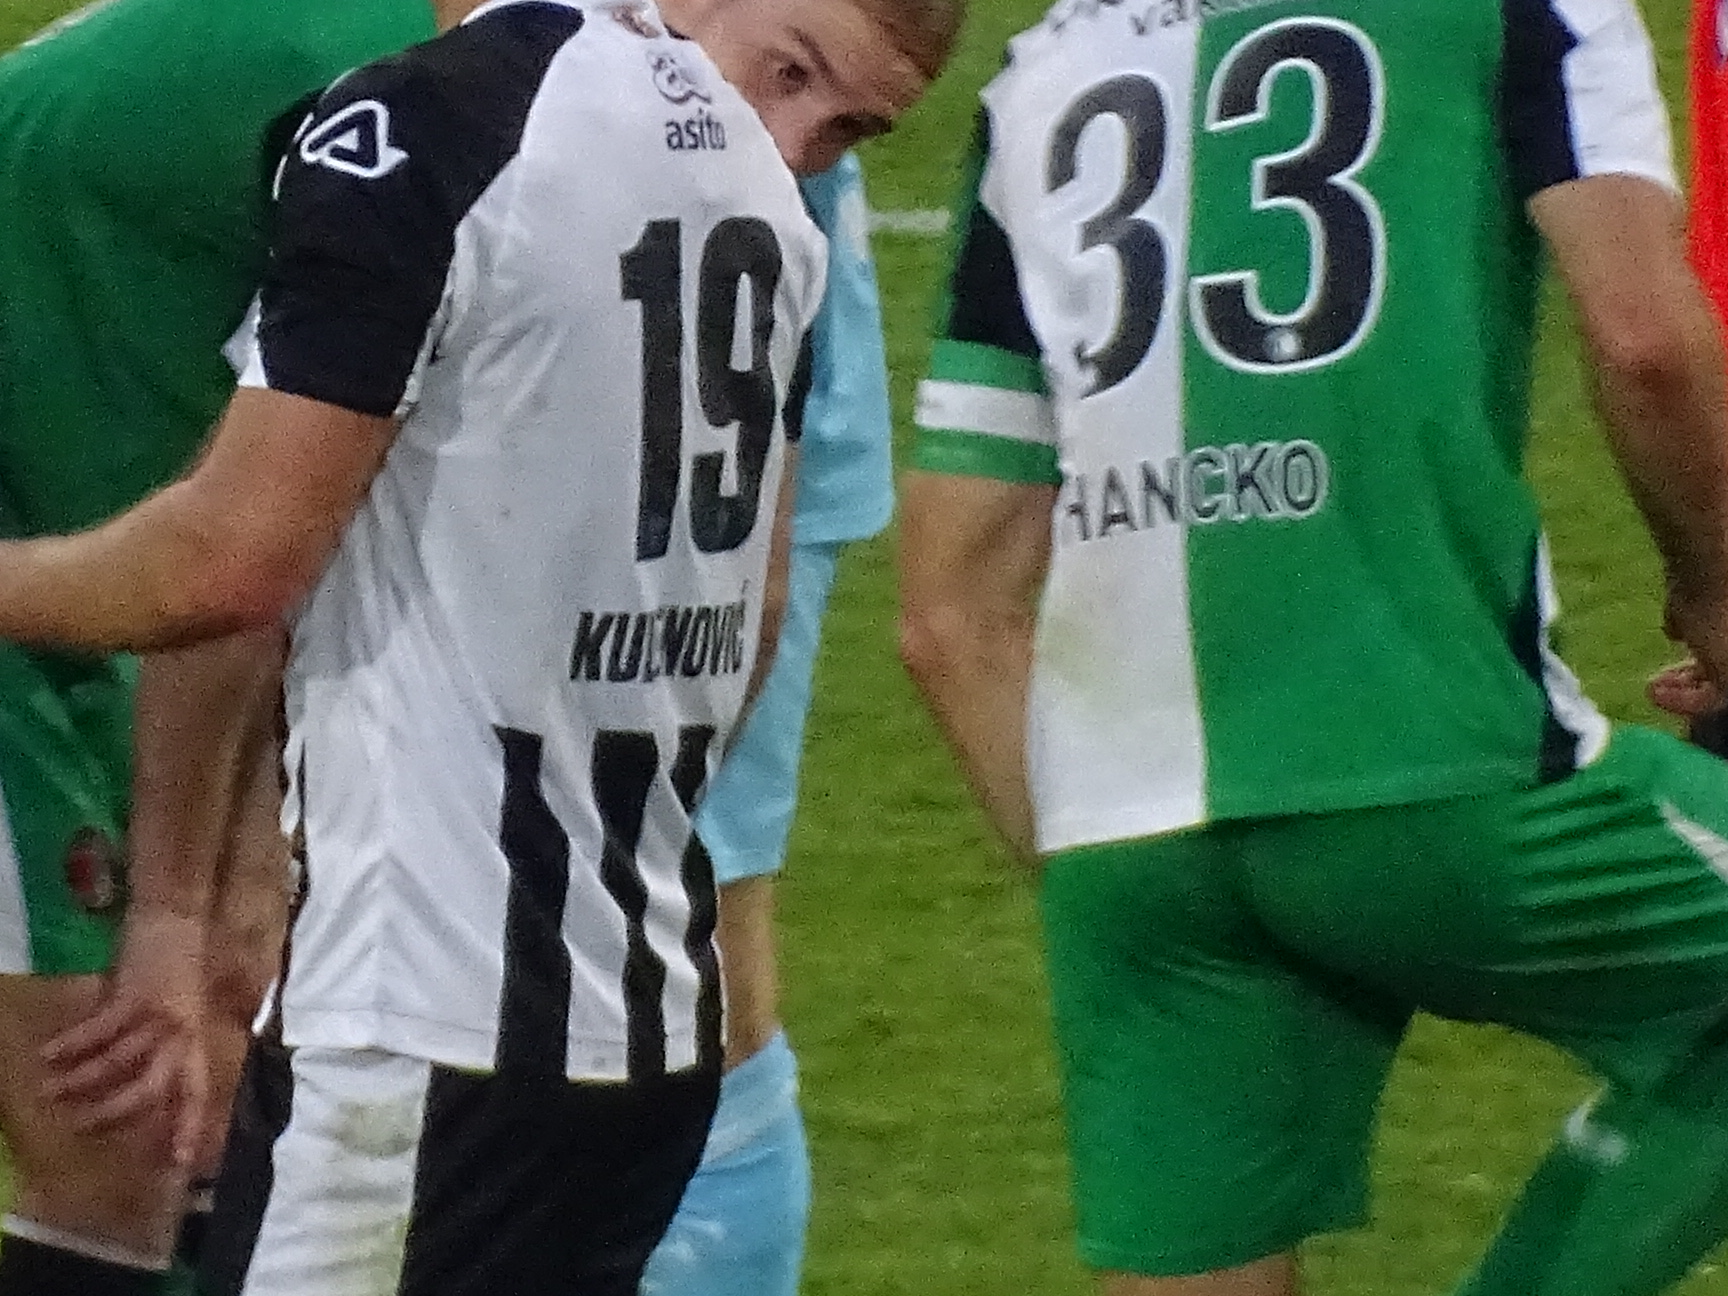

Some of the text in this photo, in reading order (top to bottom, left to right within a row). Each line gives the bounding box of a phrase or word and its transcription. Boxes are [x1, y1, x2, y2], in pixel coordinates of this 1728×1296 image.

[665, 106, 726, 150] asito
[1045, 14, 1386, 401] 33
[619, 215, 784, 562] 19
[1057, 439, 1328, 543] HANCKO
